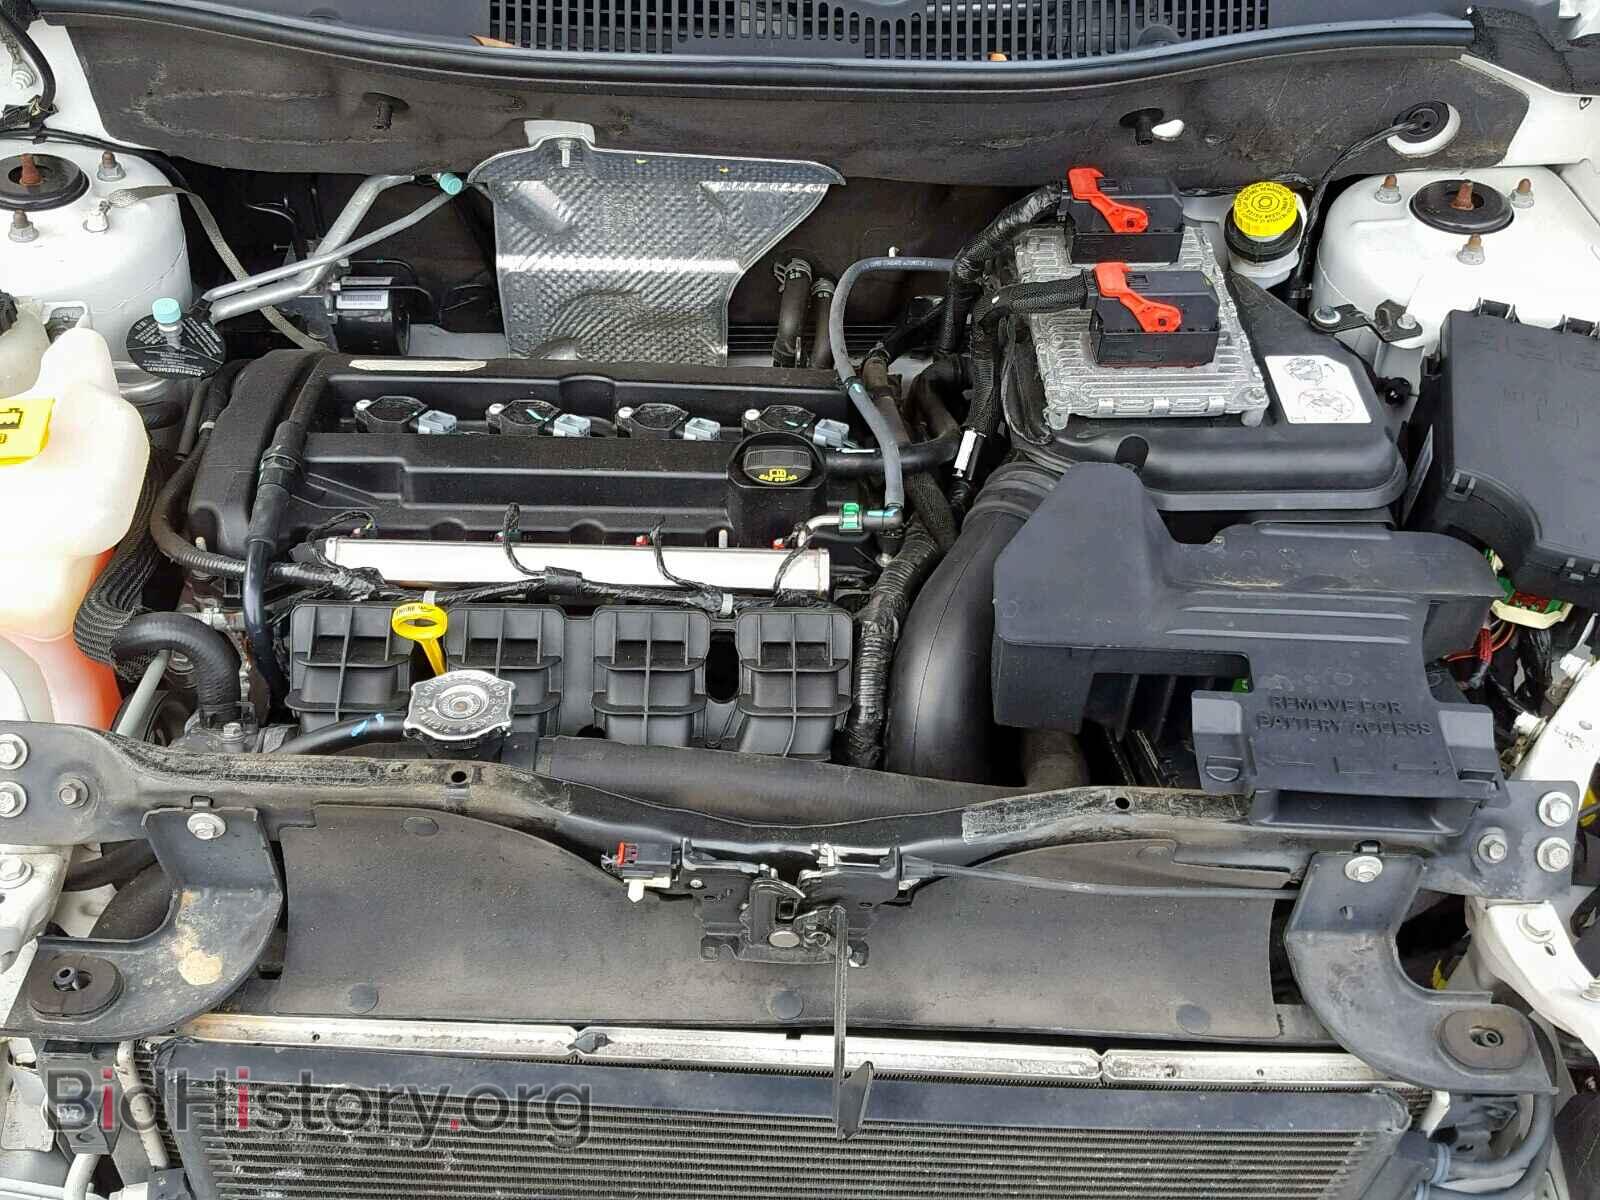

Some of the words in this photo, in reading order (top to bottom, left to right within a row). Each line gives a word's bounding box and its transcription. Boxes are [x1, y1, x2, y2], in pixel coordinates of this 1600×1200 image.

[1270, 695, 1353, 712] REMOVE
[1361, 699, 1402, 714] FOR
[1256, 713, 1342, 733] BATTERY
[1354, 720, 1433, 735] ACCESS
